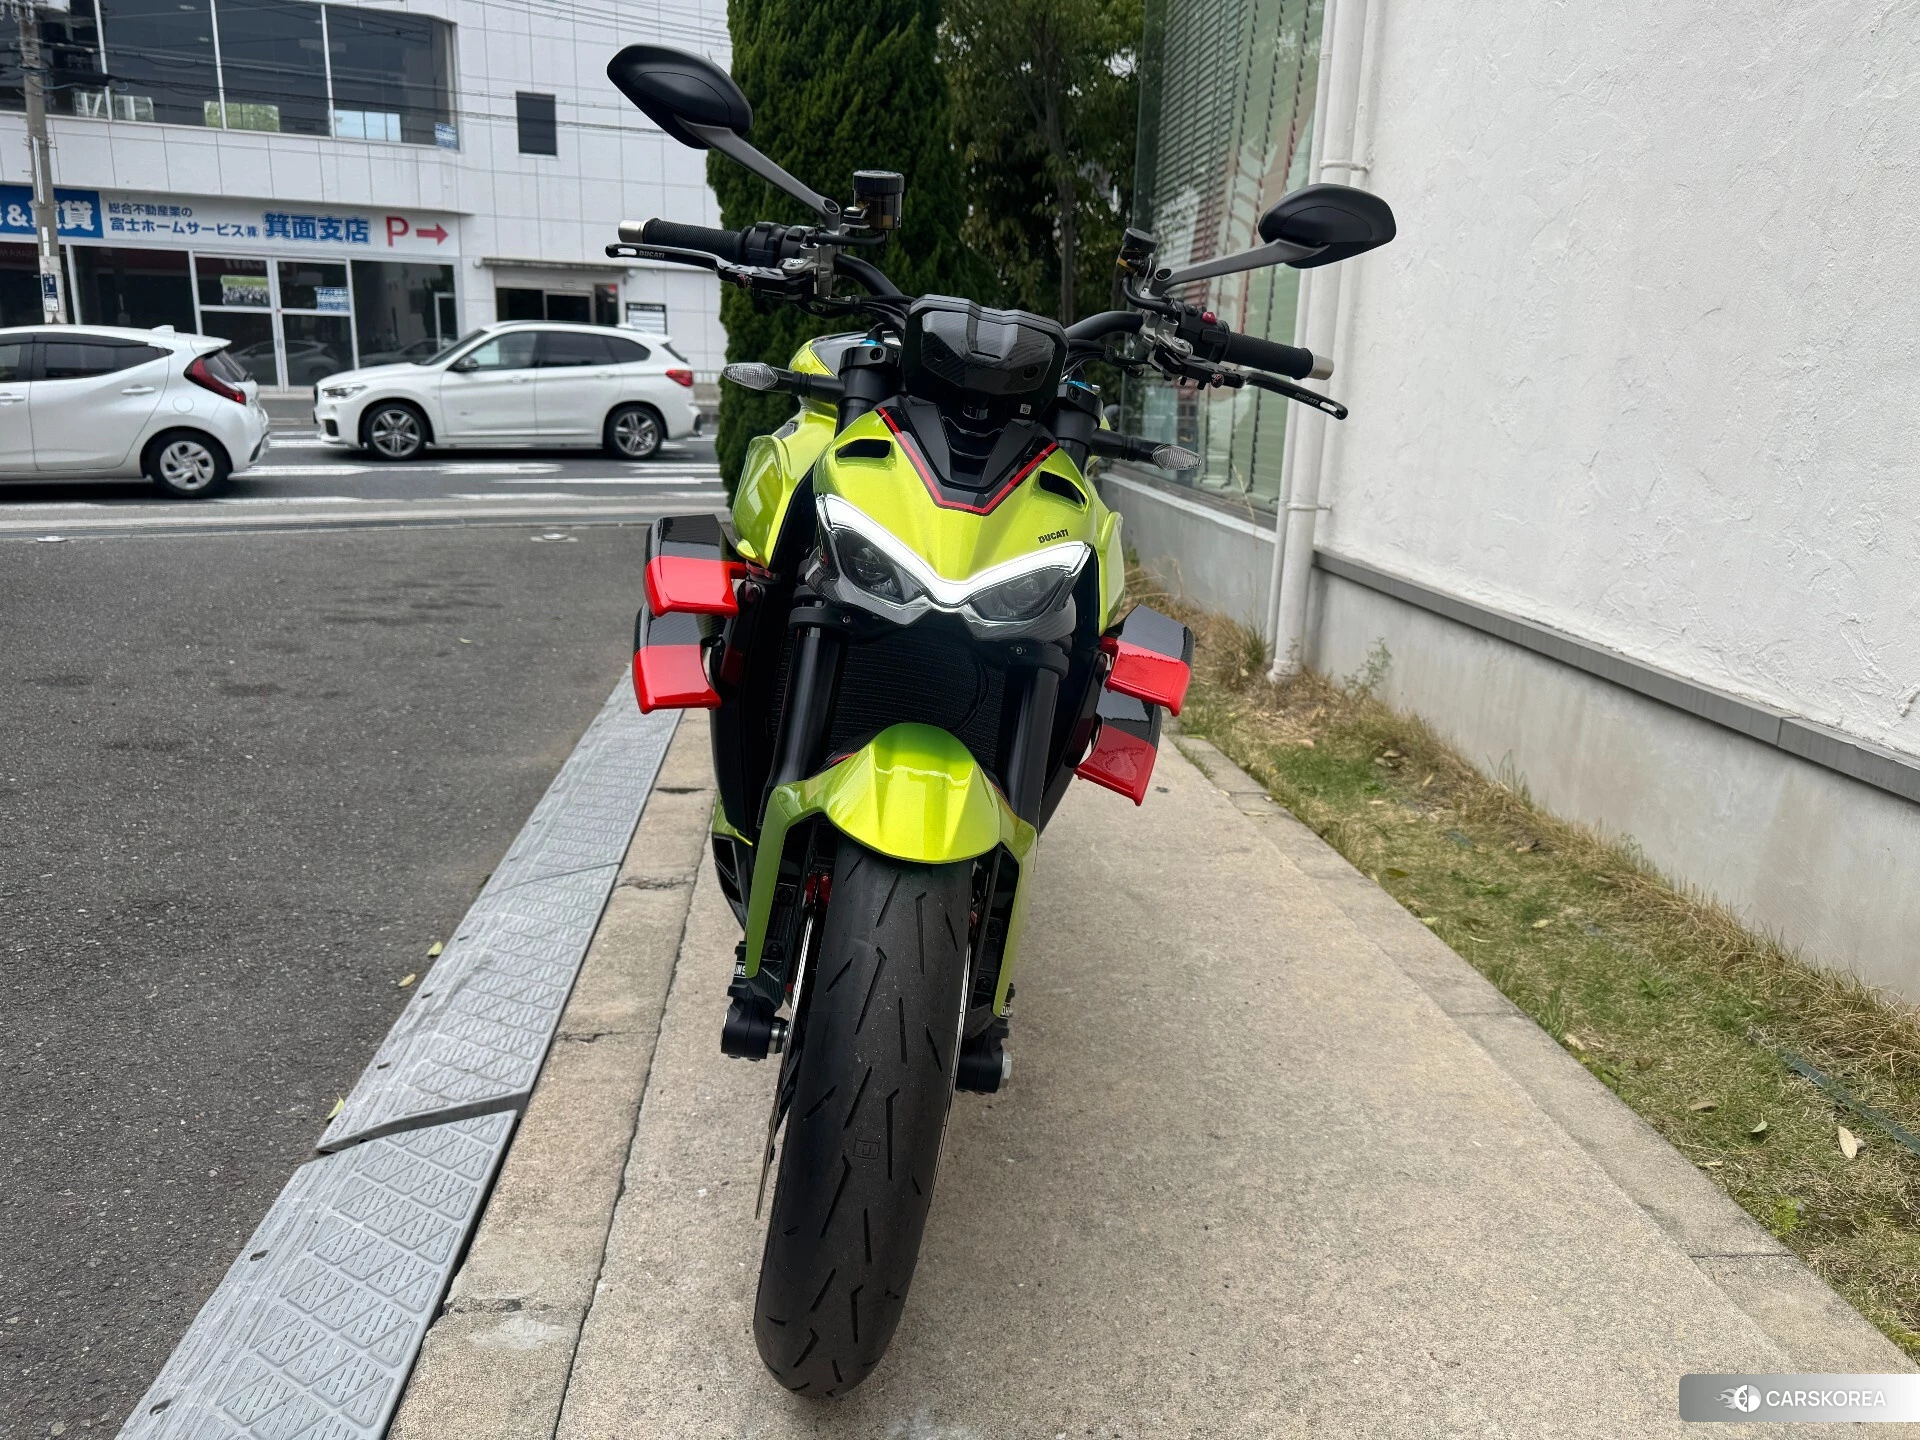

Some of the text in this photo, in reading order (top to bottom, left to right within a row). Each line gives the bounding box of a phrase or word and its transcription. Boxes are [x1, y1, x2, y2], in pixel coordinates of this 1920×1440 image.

[108, 202, 192, 218] 総合不動産業の
[263, 212, 371, 244] 箕面支店
[386, 216, 409, 247] P
[639, 250, 665, 258] DUCATI
[1295, 392, 1319, 404] DUCATI
[1037, 529, 1069, 543] DUCATI
